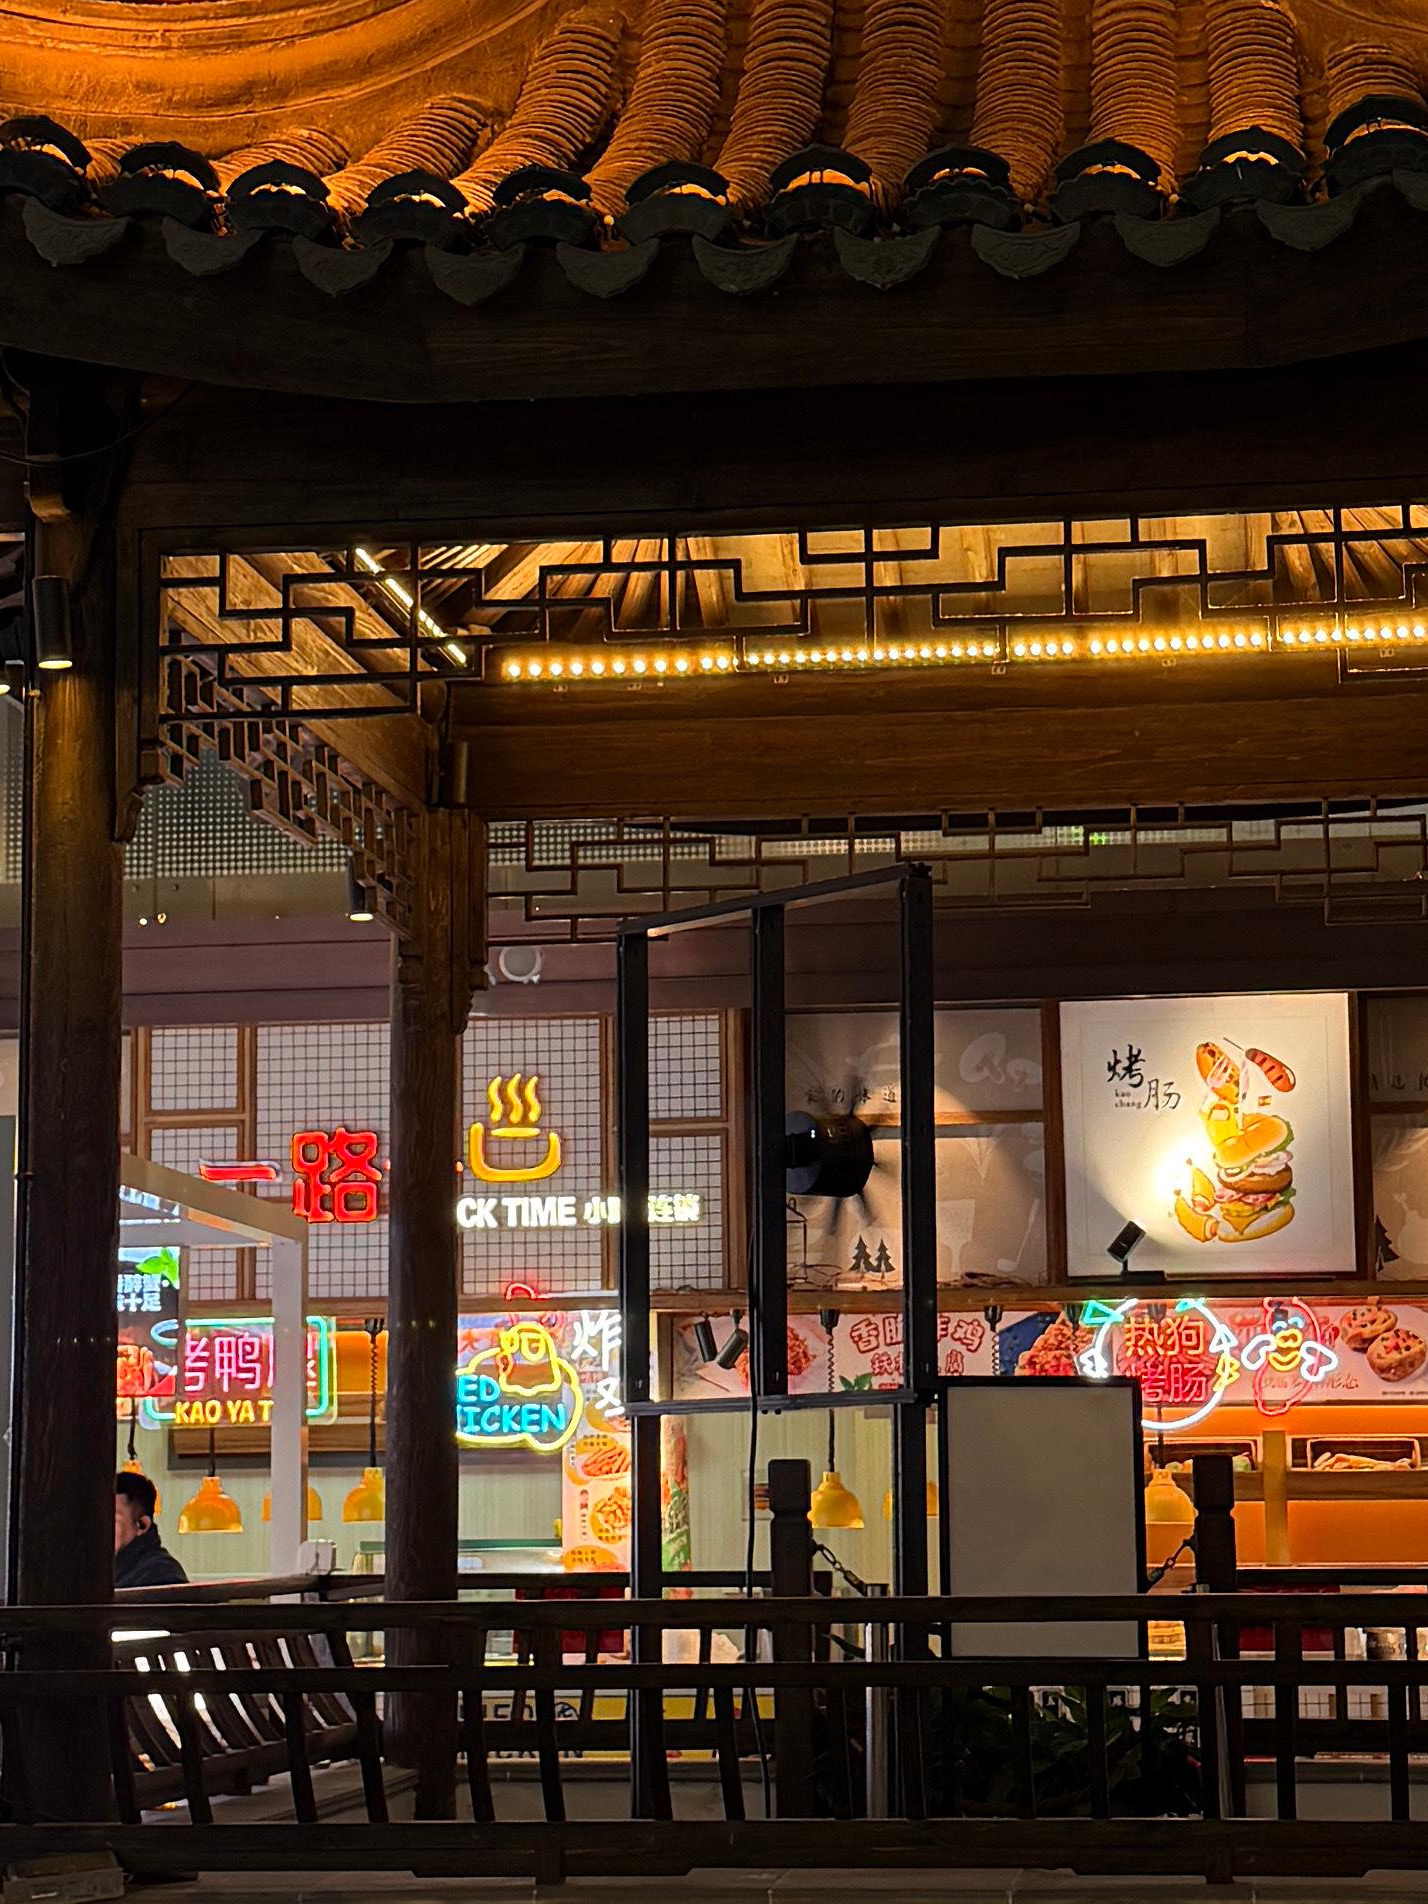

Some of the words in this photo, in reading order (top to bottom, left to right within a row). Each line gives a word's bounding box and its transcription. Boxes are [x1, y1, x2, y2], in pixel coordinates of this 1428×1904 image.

[1107, 1044, 1181, 1110] 烤肠
[501, 1196, 577, 1228] TIME
[1124, 1315, 1204, 1358] 热狗
[174, 1400, 222, 1425] KAO
[226, 1399, 256, 1424] YA
